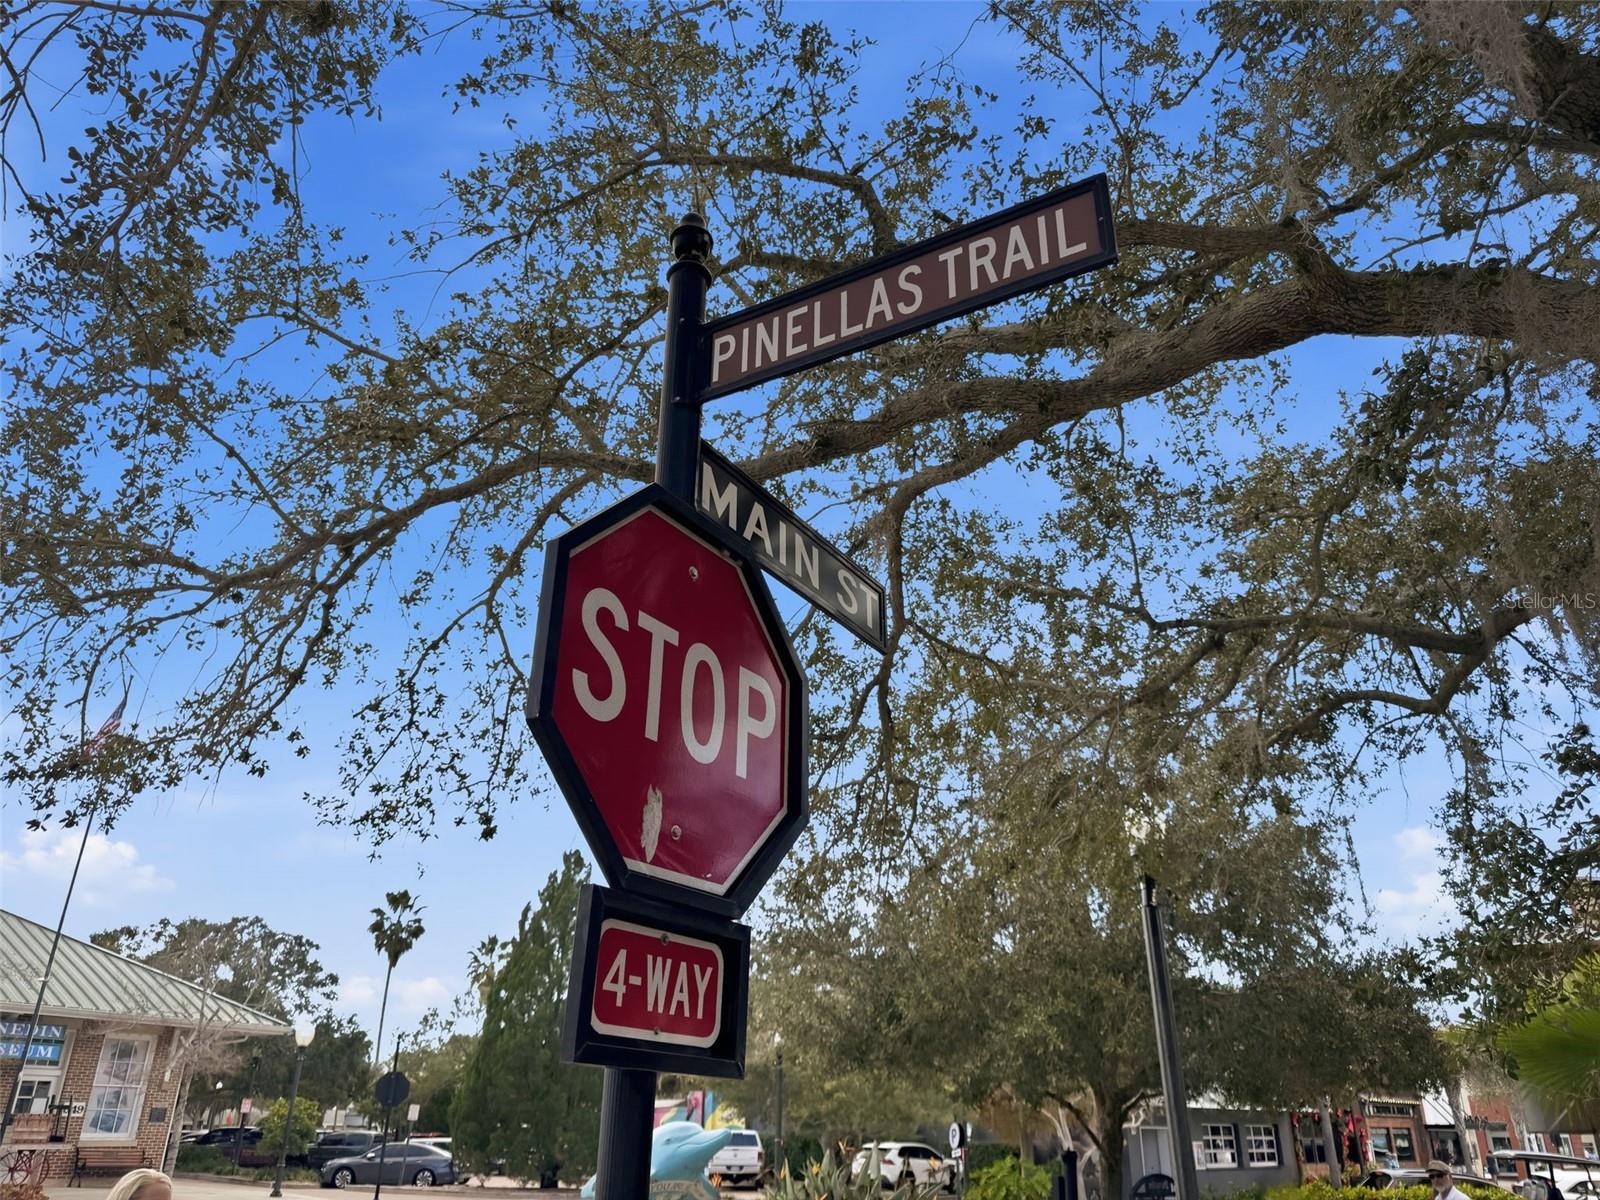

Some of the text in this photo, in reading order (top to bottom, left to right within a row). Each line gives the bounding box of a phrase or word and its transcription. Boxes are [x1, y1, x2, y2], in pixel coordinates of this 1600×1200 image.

[711, 208, 1088, 382] PINELLAS TRAIL
[701, 461, 880, 629] MAIN ST
[572, 587, 776, 780] STOP
[602, 948, 713, 1020] 4-WAY
